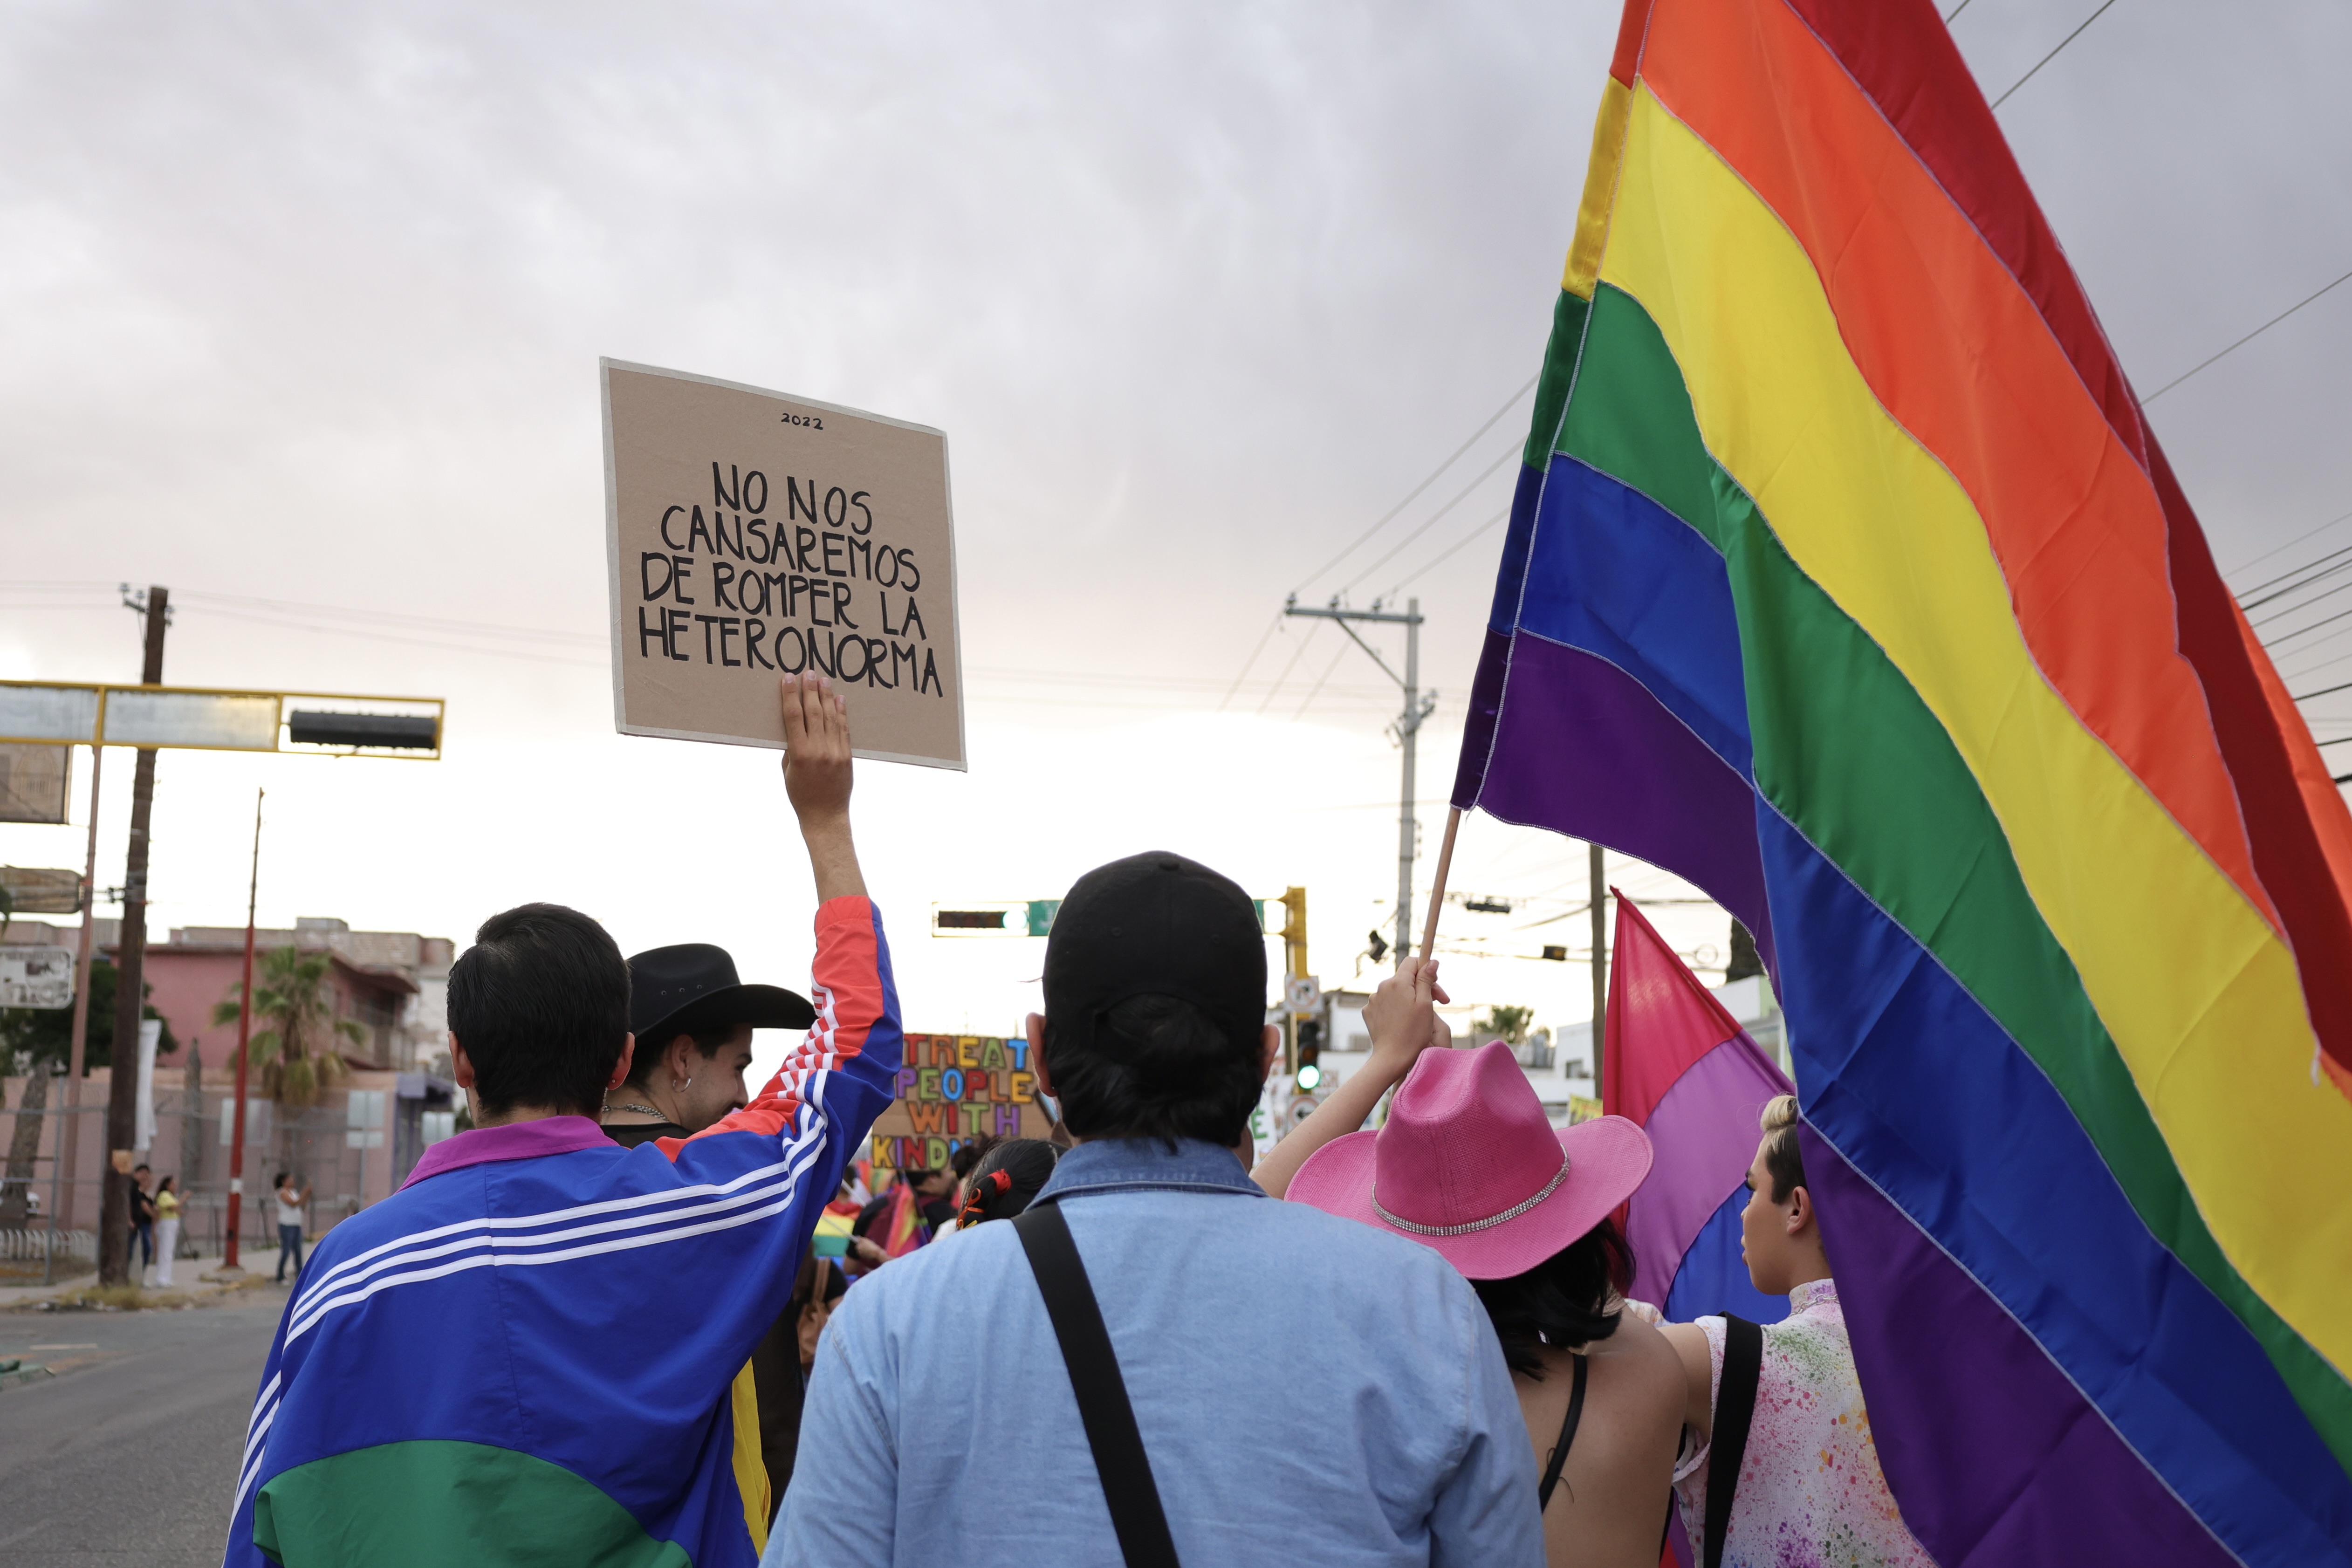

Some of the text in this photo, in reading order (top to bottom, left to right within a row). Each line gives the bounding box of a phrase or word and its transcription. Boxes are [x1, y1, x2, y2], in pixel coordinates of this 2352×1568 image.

[781, 413, 823, 430] 2022
[712, 461, 872, 535] NO NOS
[661, 505, 920, 593] CANSAREMOS
[641, 551, 927, 641] DE ROMPER LA
[638, 606, 943, 698] HETERONORMA
[904, 1034, 1029, 1069] TREAT
[896, 1068, 1033, 1103] PEOPLE
[906, 1101, 1021, 1136] WITH
